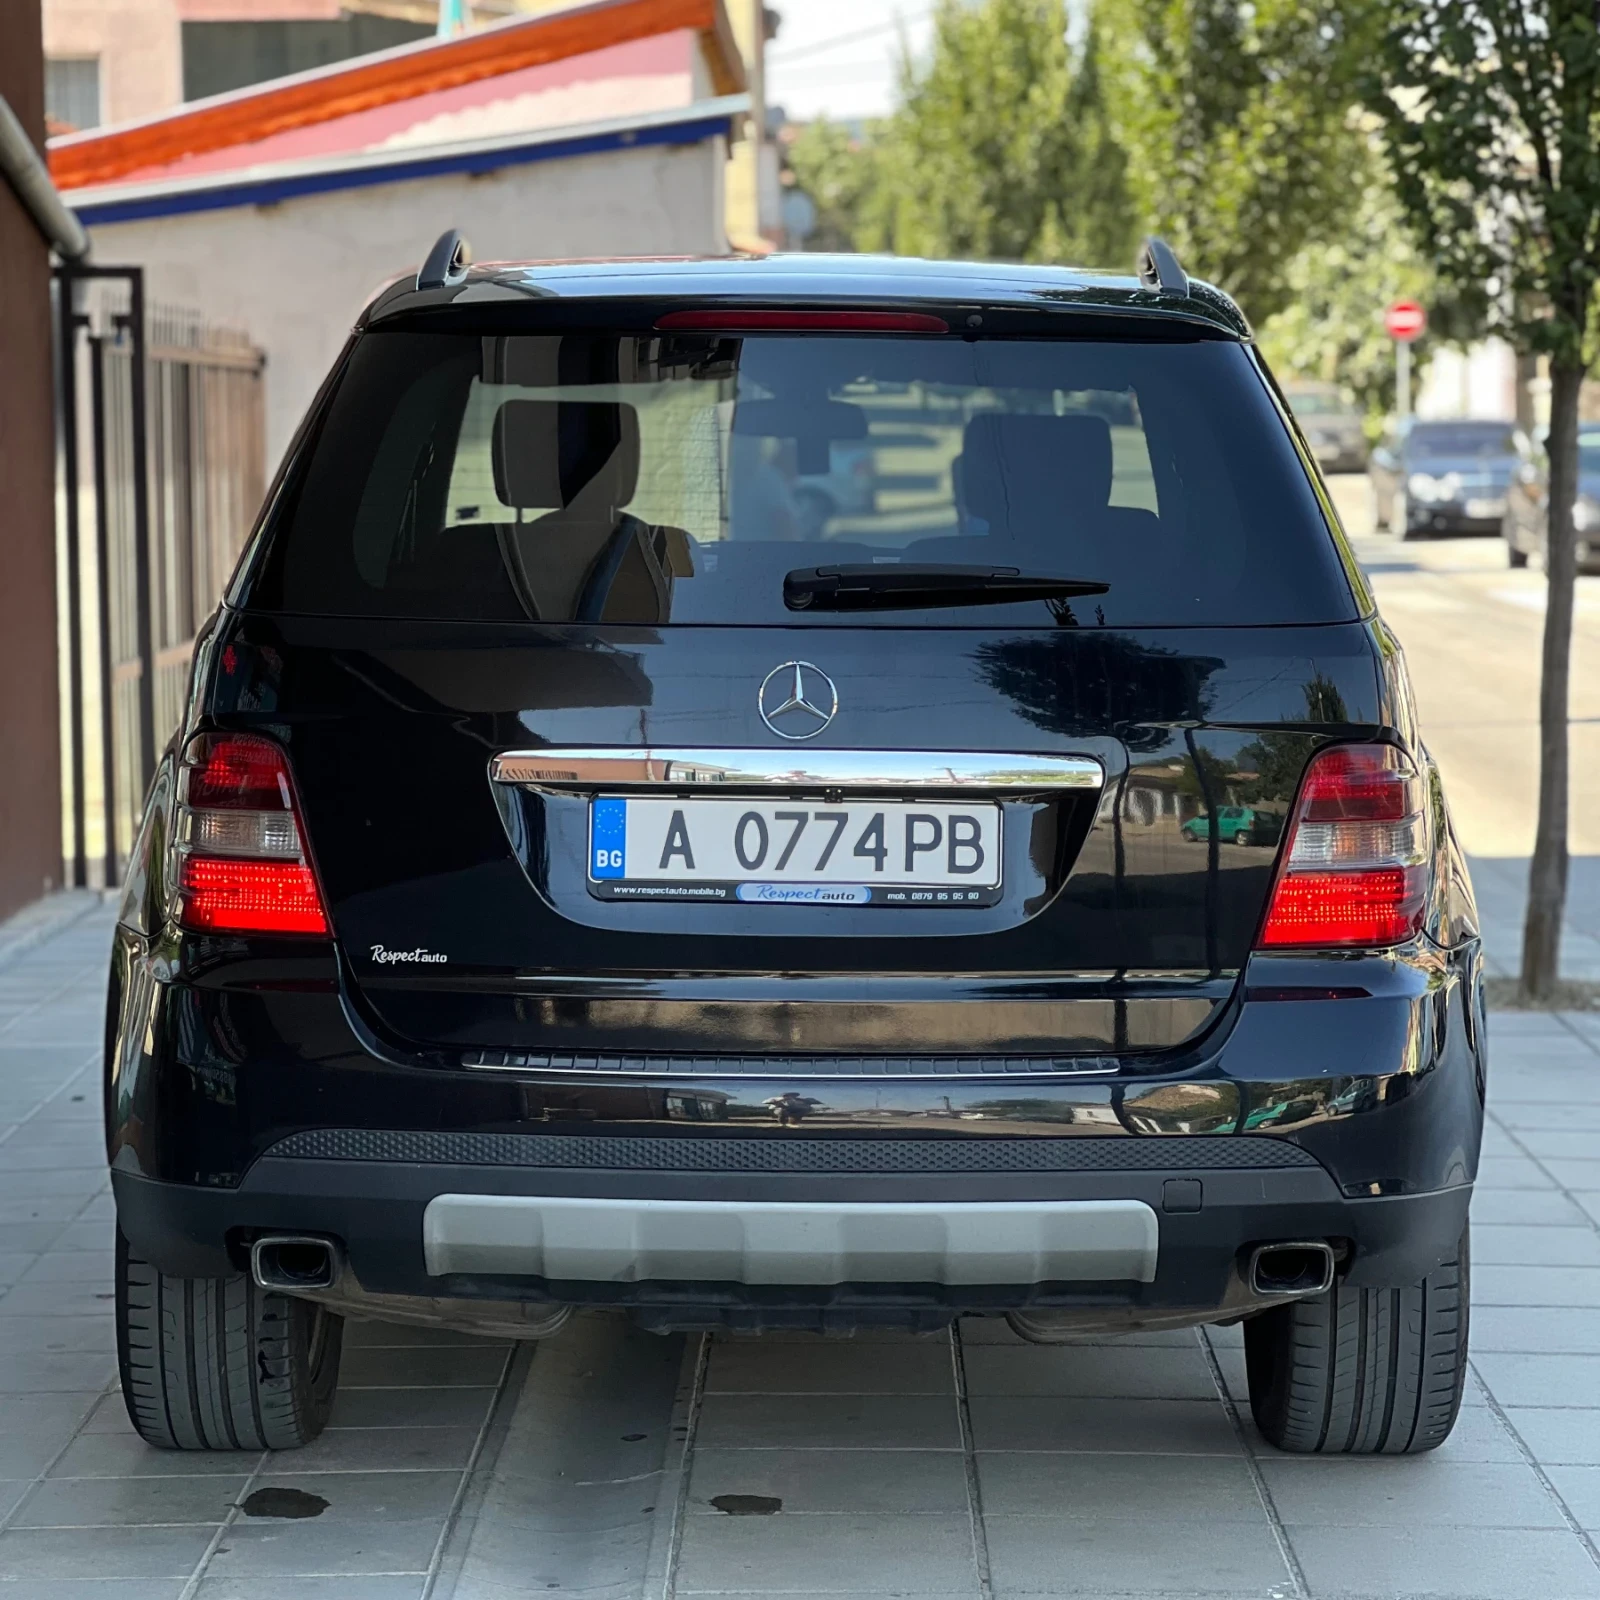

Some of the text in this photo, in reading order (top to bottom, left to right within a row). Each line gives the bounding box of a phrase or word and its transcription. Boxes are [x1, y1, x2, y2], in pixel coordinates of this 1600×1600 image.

[658, 810, 696, 869] A
[597, 849, 623, 868] BG
[613, 886, 726, 898] www.respectauto.mobile.bg
[887, 892, 979, 901] mob. 0879 95 95 90
